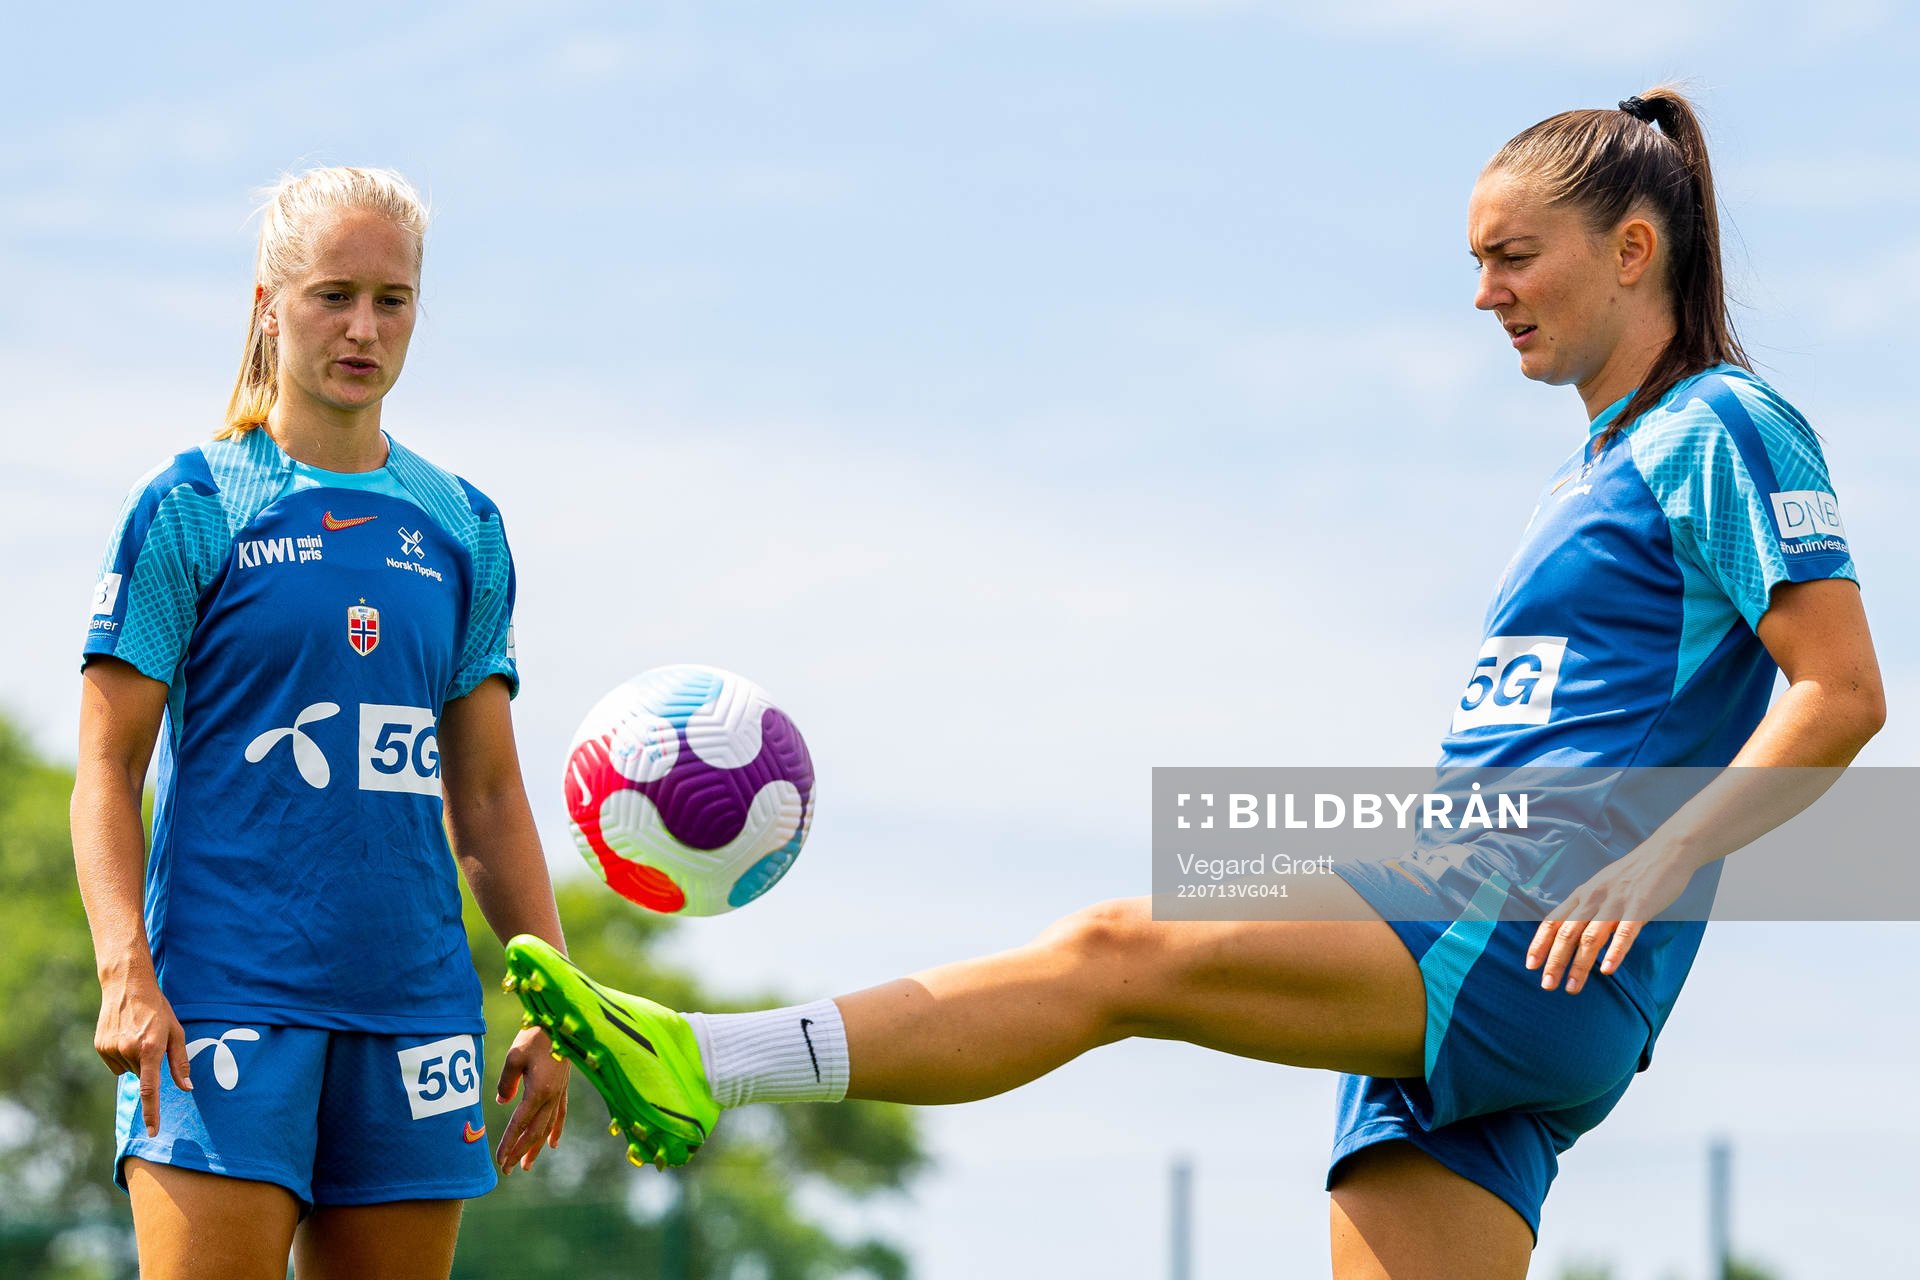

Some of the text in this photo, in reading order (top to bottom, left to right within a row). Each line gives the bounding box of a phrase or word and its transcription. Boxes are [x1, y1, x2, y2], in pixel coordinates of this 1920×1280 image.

[1782, 491, 1840, 535] DNB
[238, 537, 296, 569] KIWI
[297, 534, 323, 549] mini
[299, 548, 323, 564] pris
[1780, 539, 1848, 555] #huninveste
[386, 557, 443, 582] Norsk Tipping
[1460, 656, 1543, 712] 5G
[370, 722, 441, 779] 5G
[417, 1049, 475, 1102] 5G
